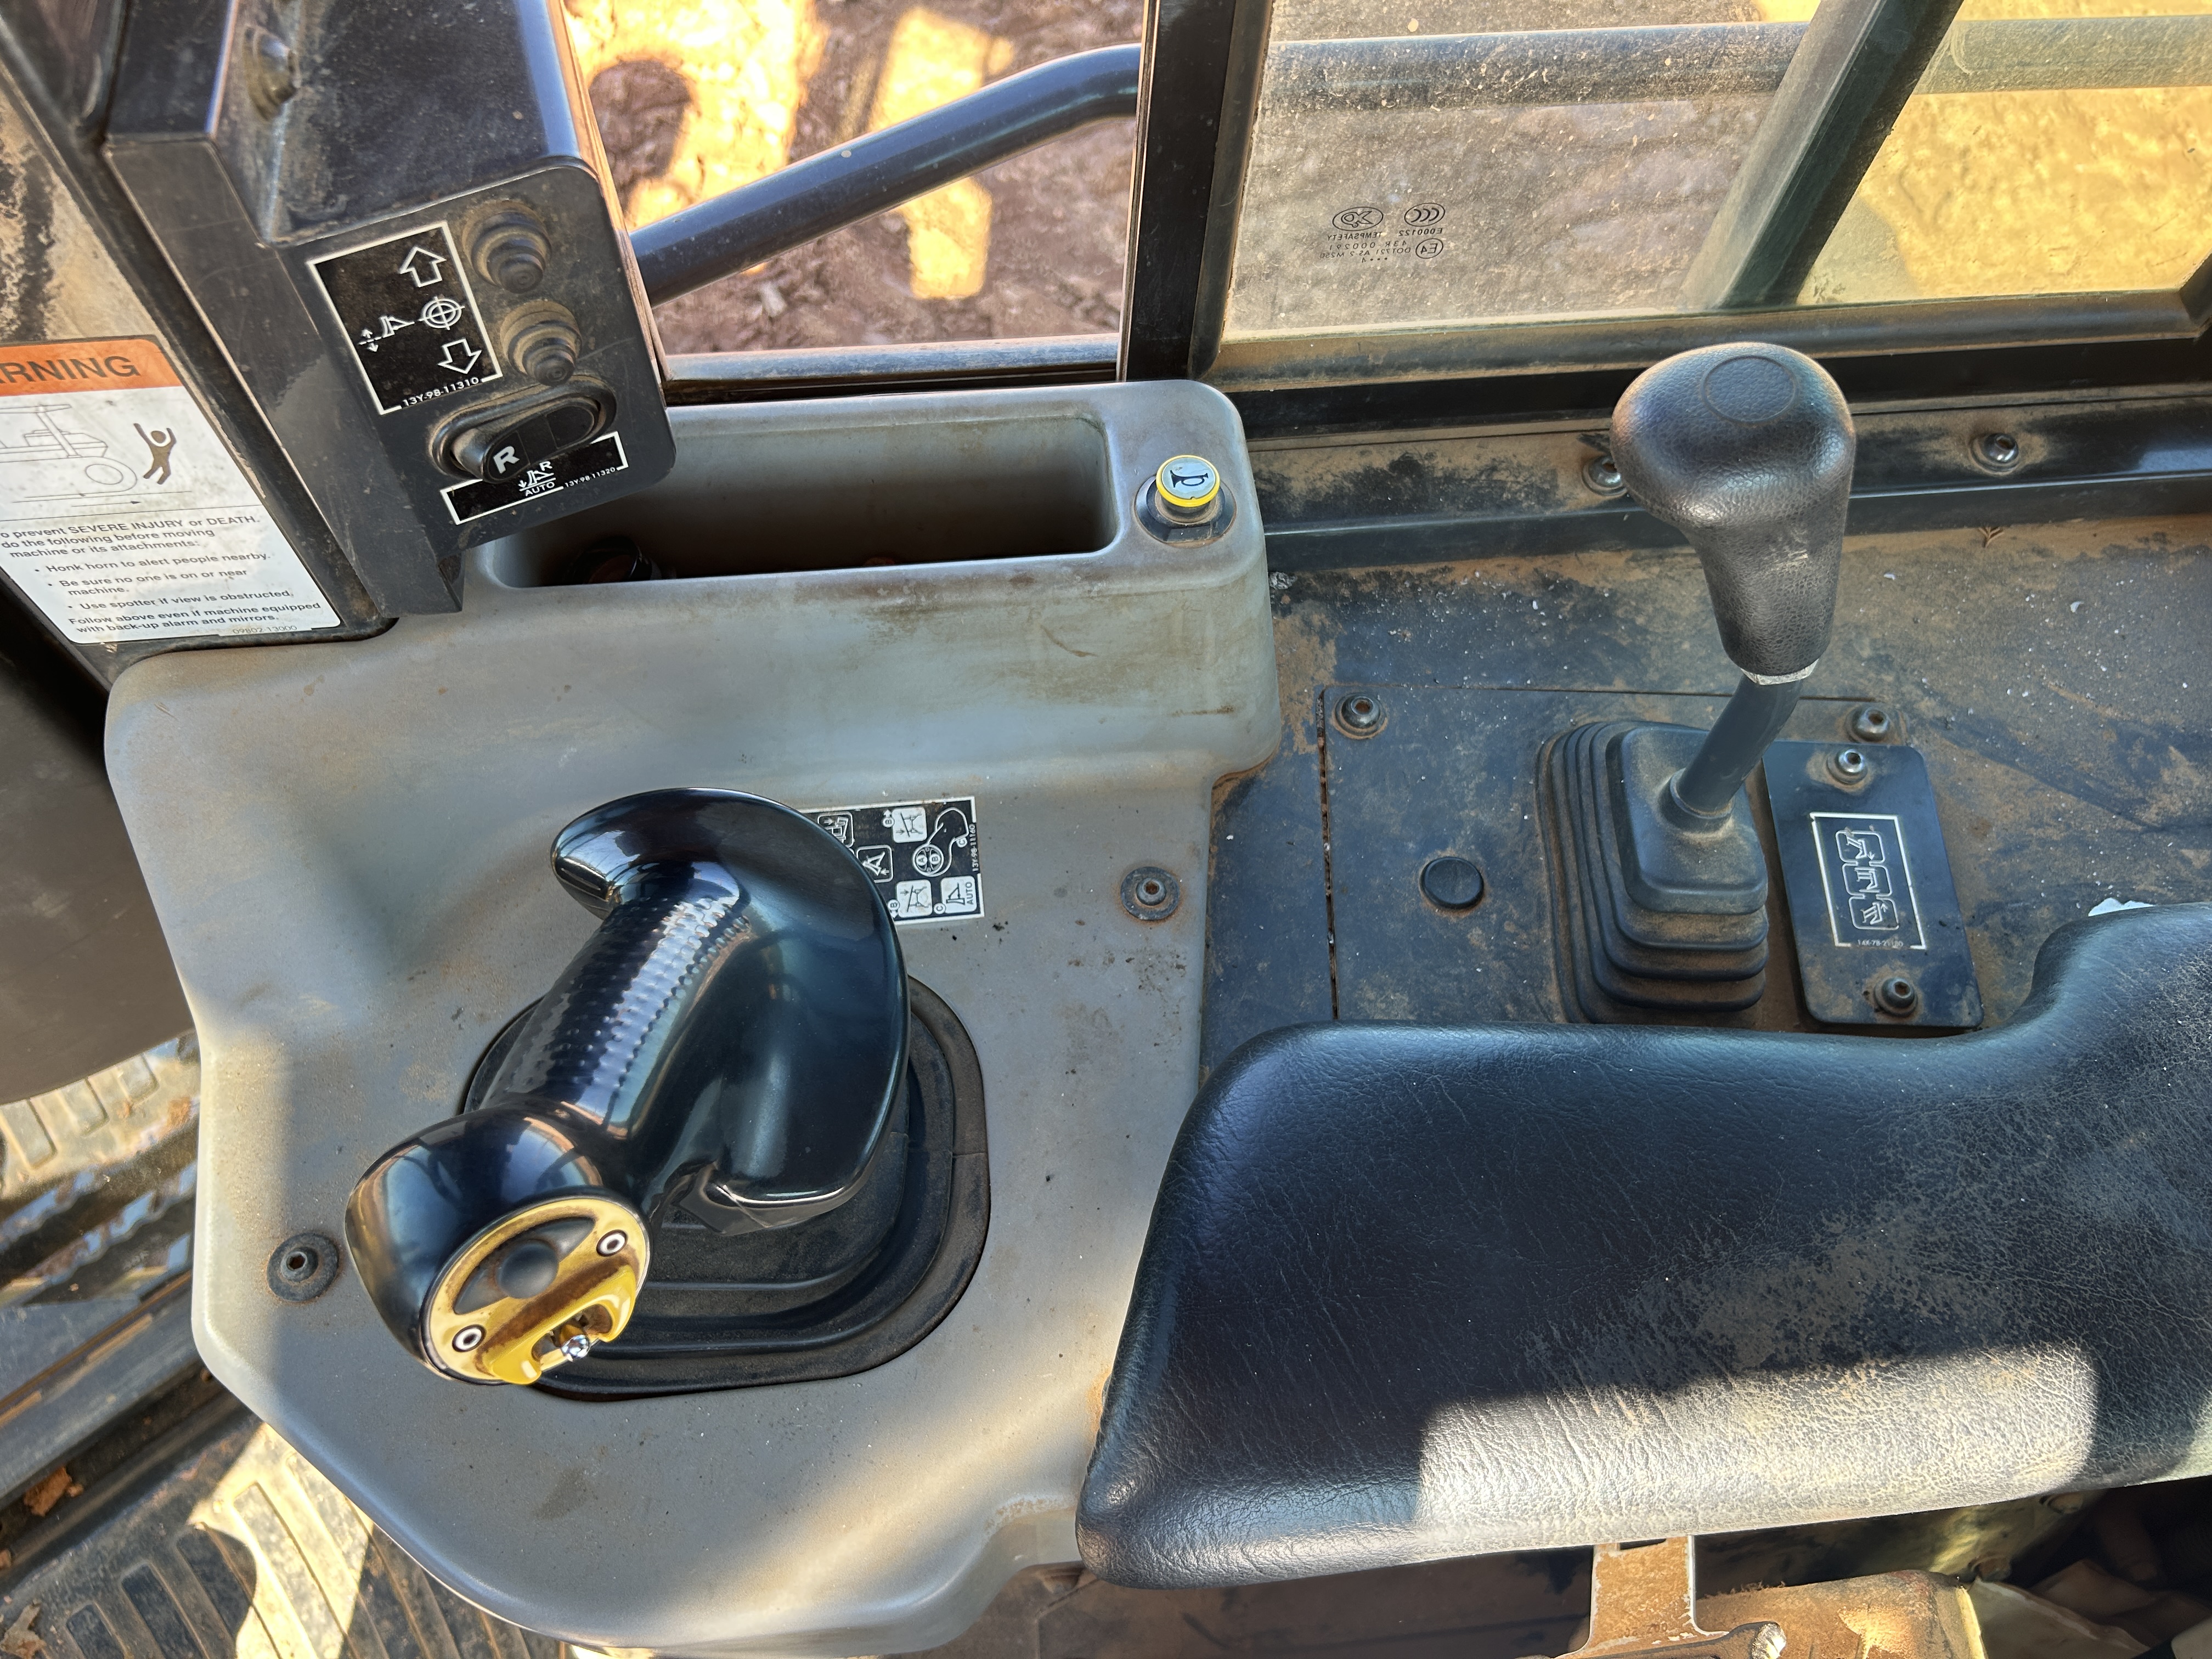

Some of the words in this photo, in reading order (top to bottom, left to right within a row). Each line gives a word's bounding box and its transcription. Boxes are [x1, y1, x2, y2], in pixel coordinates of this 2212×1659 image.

[402, 376, 479, 407] 13Y-98-11310
[494, 445, 520, 474] R
[539, 461, 553, 471] R
[525, 482, 555, 496] AUTO
[13, 528, 67, 538] prevent
[67, 523, 129, 534] SEVERE
[131, 520, 183, 531] INJURY
[47, 535, 113, 546] following
[114, 532, 160, 542] before
[163, 529, 215, 537] moving
[10, 549, 68, 557] machine
[110, 540, 199, 551] attachments:
[46, 563, 84, 572] Honk
[85, 562, 119, 570] horn
[138, 558, 170, 566] alert
[172, 555, 218, 566] people
[222, 552, 270, 561] nearby.
[68, 586, 129, 596] machine.
[110, 599, 155, 608] spotter
[171, 594, 202, 603] view
[219, 590, 294, 600] obstructed.
[69, 617, 112, 625] Follow
[116, 613, 155, 622] above
[204, 606, 259, 616] machine
[262, 603, 321, 612] equipped
[76, 624, 104, 633] with
[106, 621, 159, 630] back-up
[228, 613, 279, 622] mirrors.
[965, 881, 974, 905] AUTO
